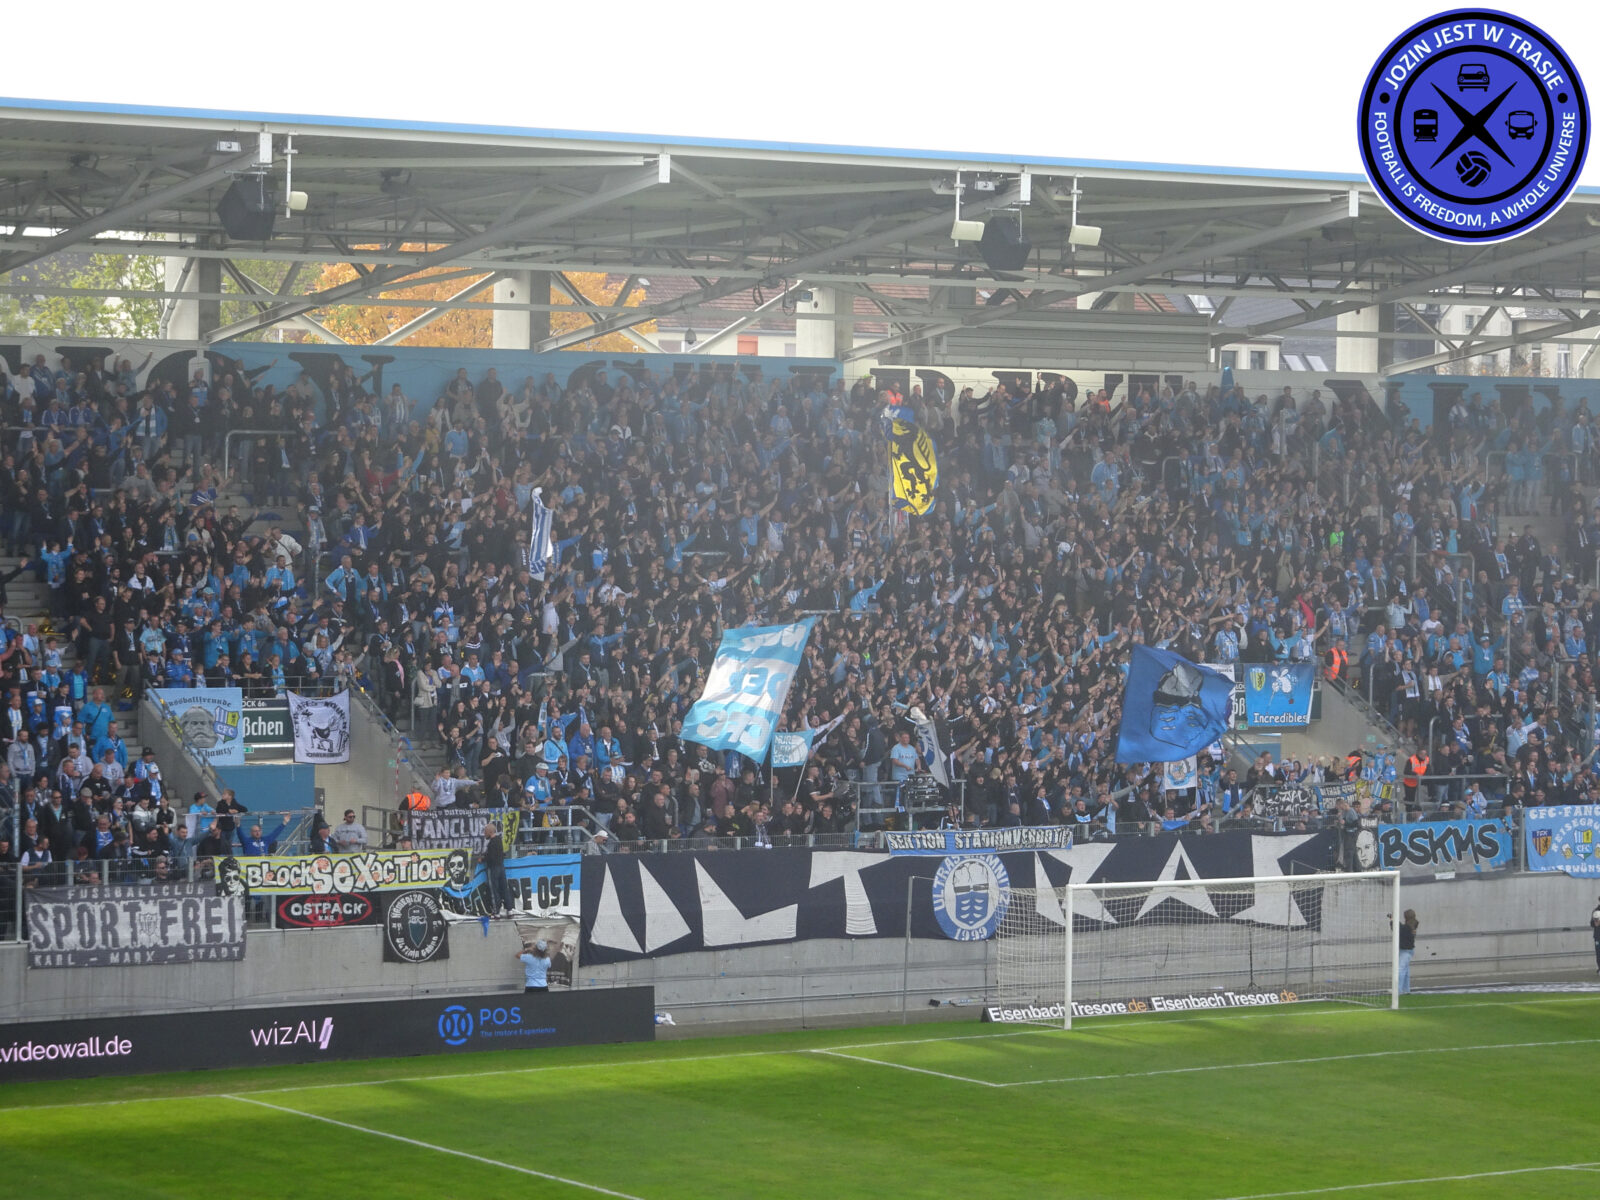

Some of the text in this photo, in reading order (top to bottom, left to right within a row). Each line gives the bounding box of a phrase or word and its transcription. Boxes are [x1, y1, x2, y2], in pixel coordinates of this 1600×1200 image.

[242, 715, 284, 738] ßchen
[1253, 712, 1308, 723] Incredibles
[216, 724, 235, 736] CFC
[411, 817, 487, 838] FANCLUB
[888, 833, 946, 849] SEKTION
[1380, 822, 1500, 867] BSKMS
[67, 884, 204, 900] FUSSBALLCLUB
[538, 875, 574, 910] OST
[291, 903, 361, 916] OSTPACK
[29, 898, 238, 950] SPORT FREI
[954, 926, 988, 941] 1999
[34, 954, 75, 966] KARL
[110, 951, 155, 964] MARX
[189, 948, 239, 960] STADT
[987, 998, 1148, 1023] Eisenbach Tresore.de
[1152, 990, 1298, 1012] Eisenbach Tresore.de
